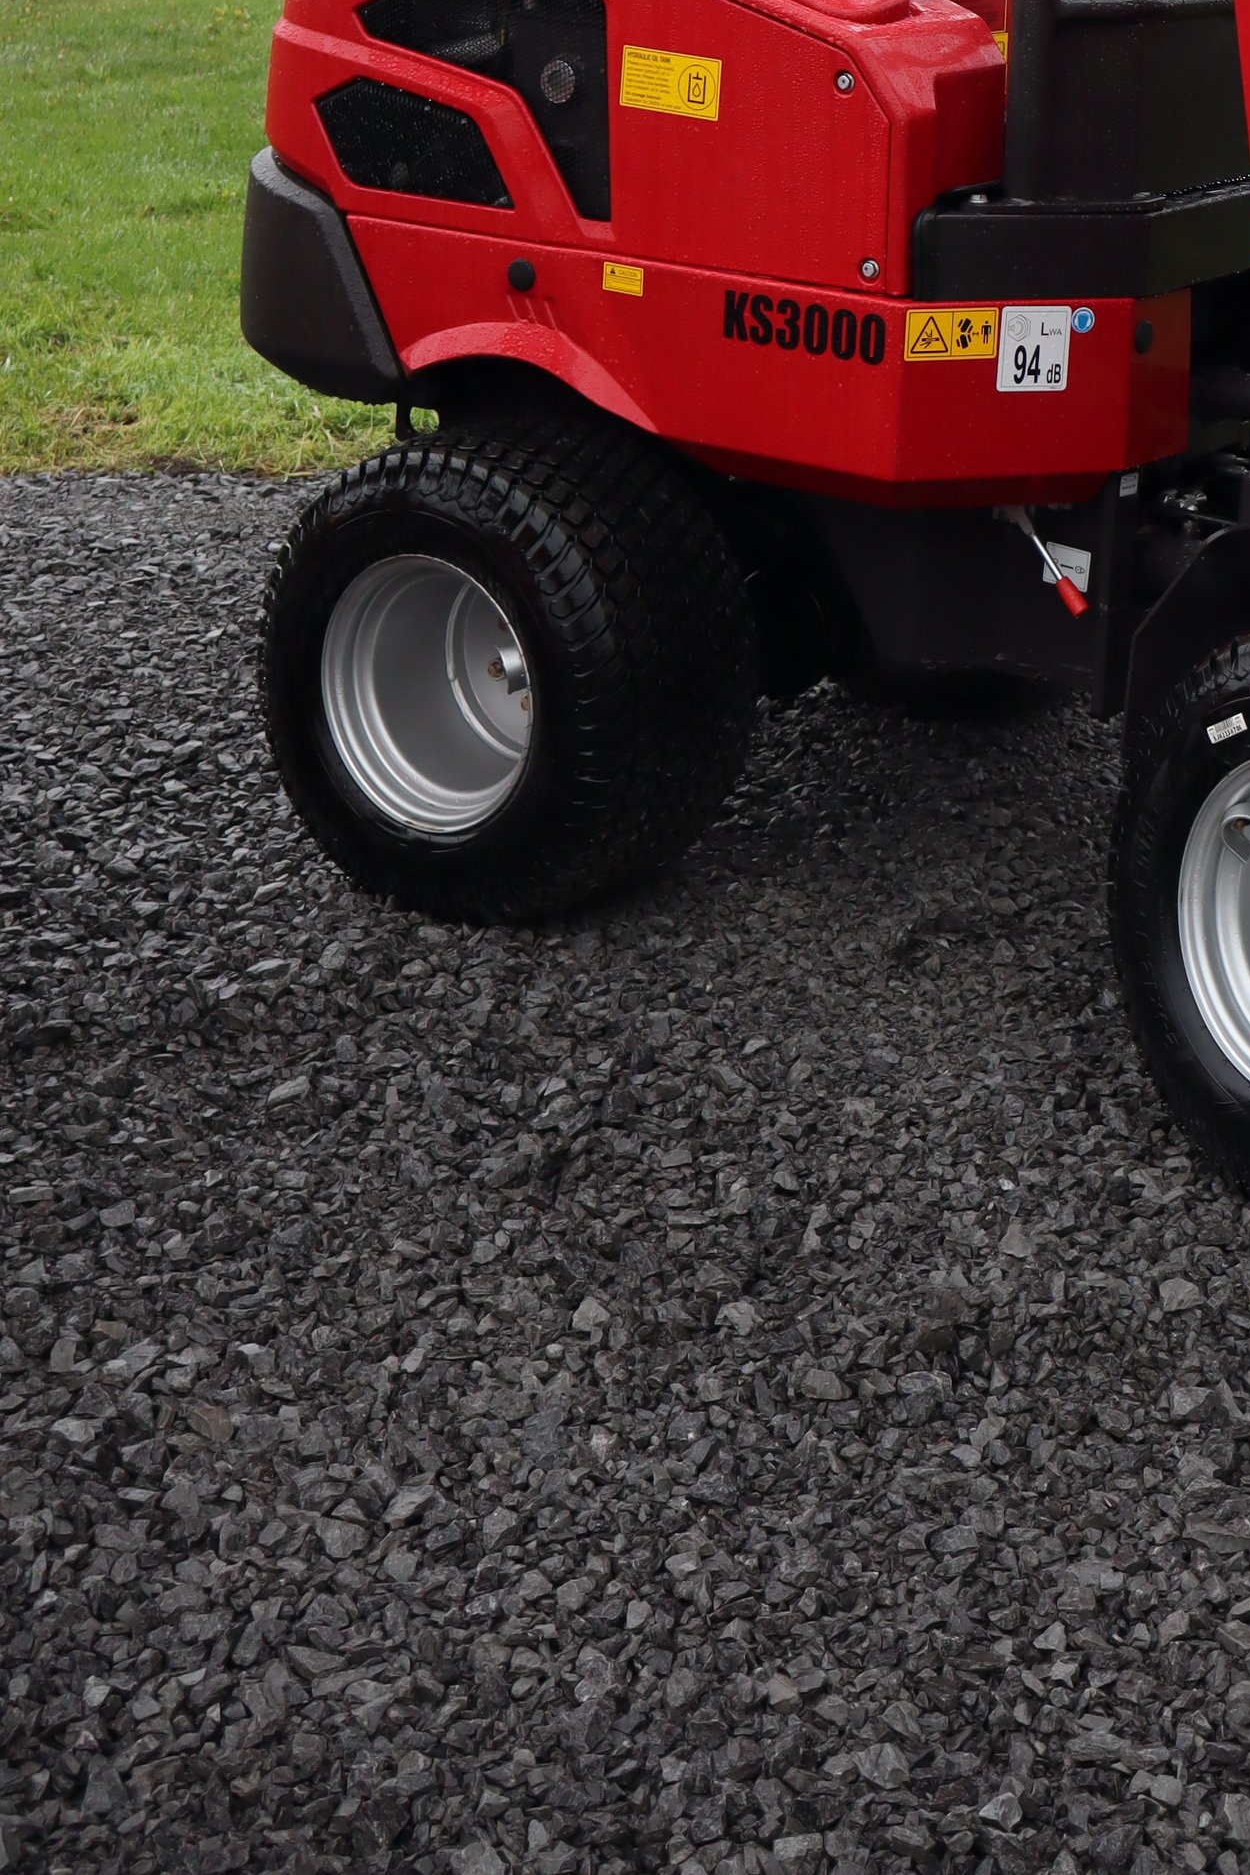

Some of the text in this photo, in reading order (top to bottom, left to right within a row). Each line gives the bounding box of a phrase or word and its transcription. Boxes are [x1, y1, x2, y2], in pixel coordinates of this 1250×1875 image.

[723, 289, 886, 365] KS3000
[1013, 344, 1061, 384] 94 dB
